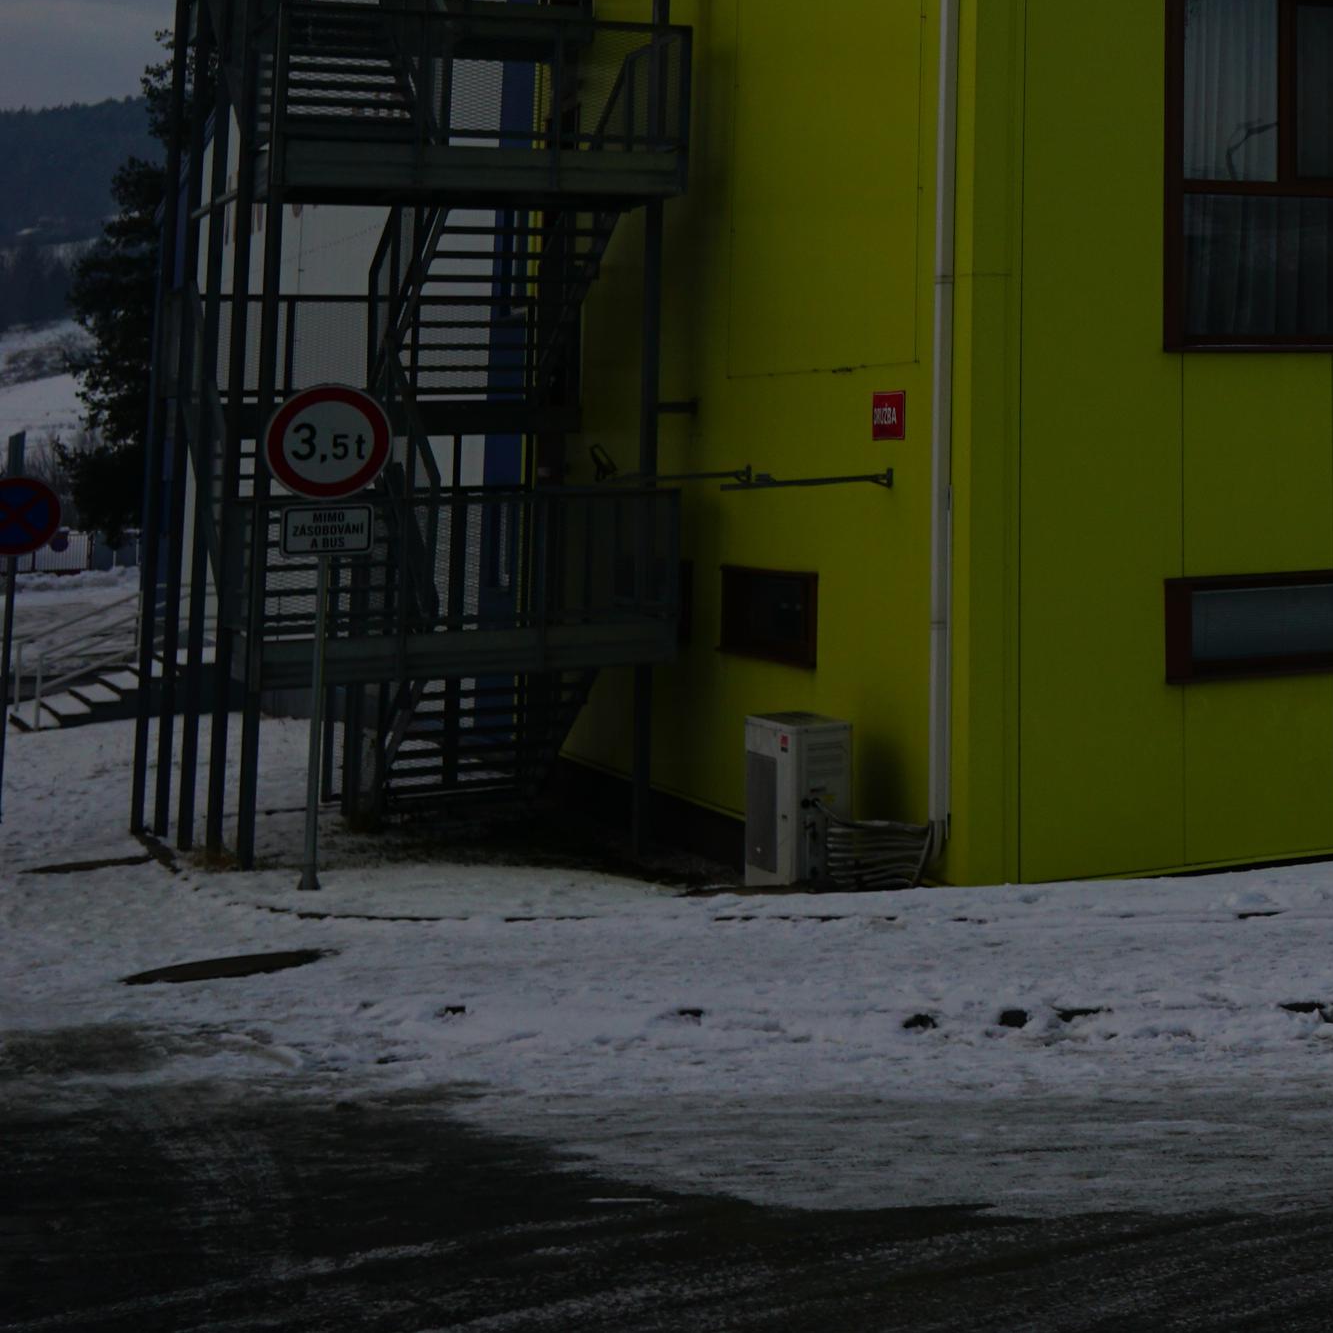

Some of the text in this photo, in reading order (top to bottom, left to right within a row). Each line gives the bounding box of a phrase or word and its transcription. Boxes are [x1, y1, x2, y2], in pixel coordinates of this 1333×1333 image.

[312, 511, 345, 524] MIMO
[310, 537, 345, 549] A BUS
